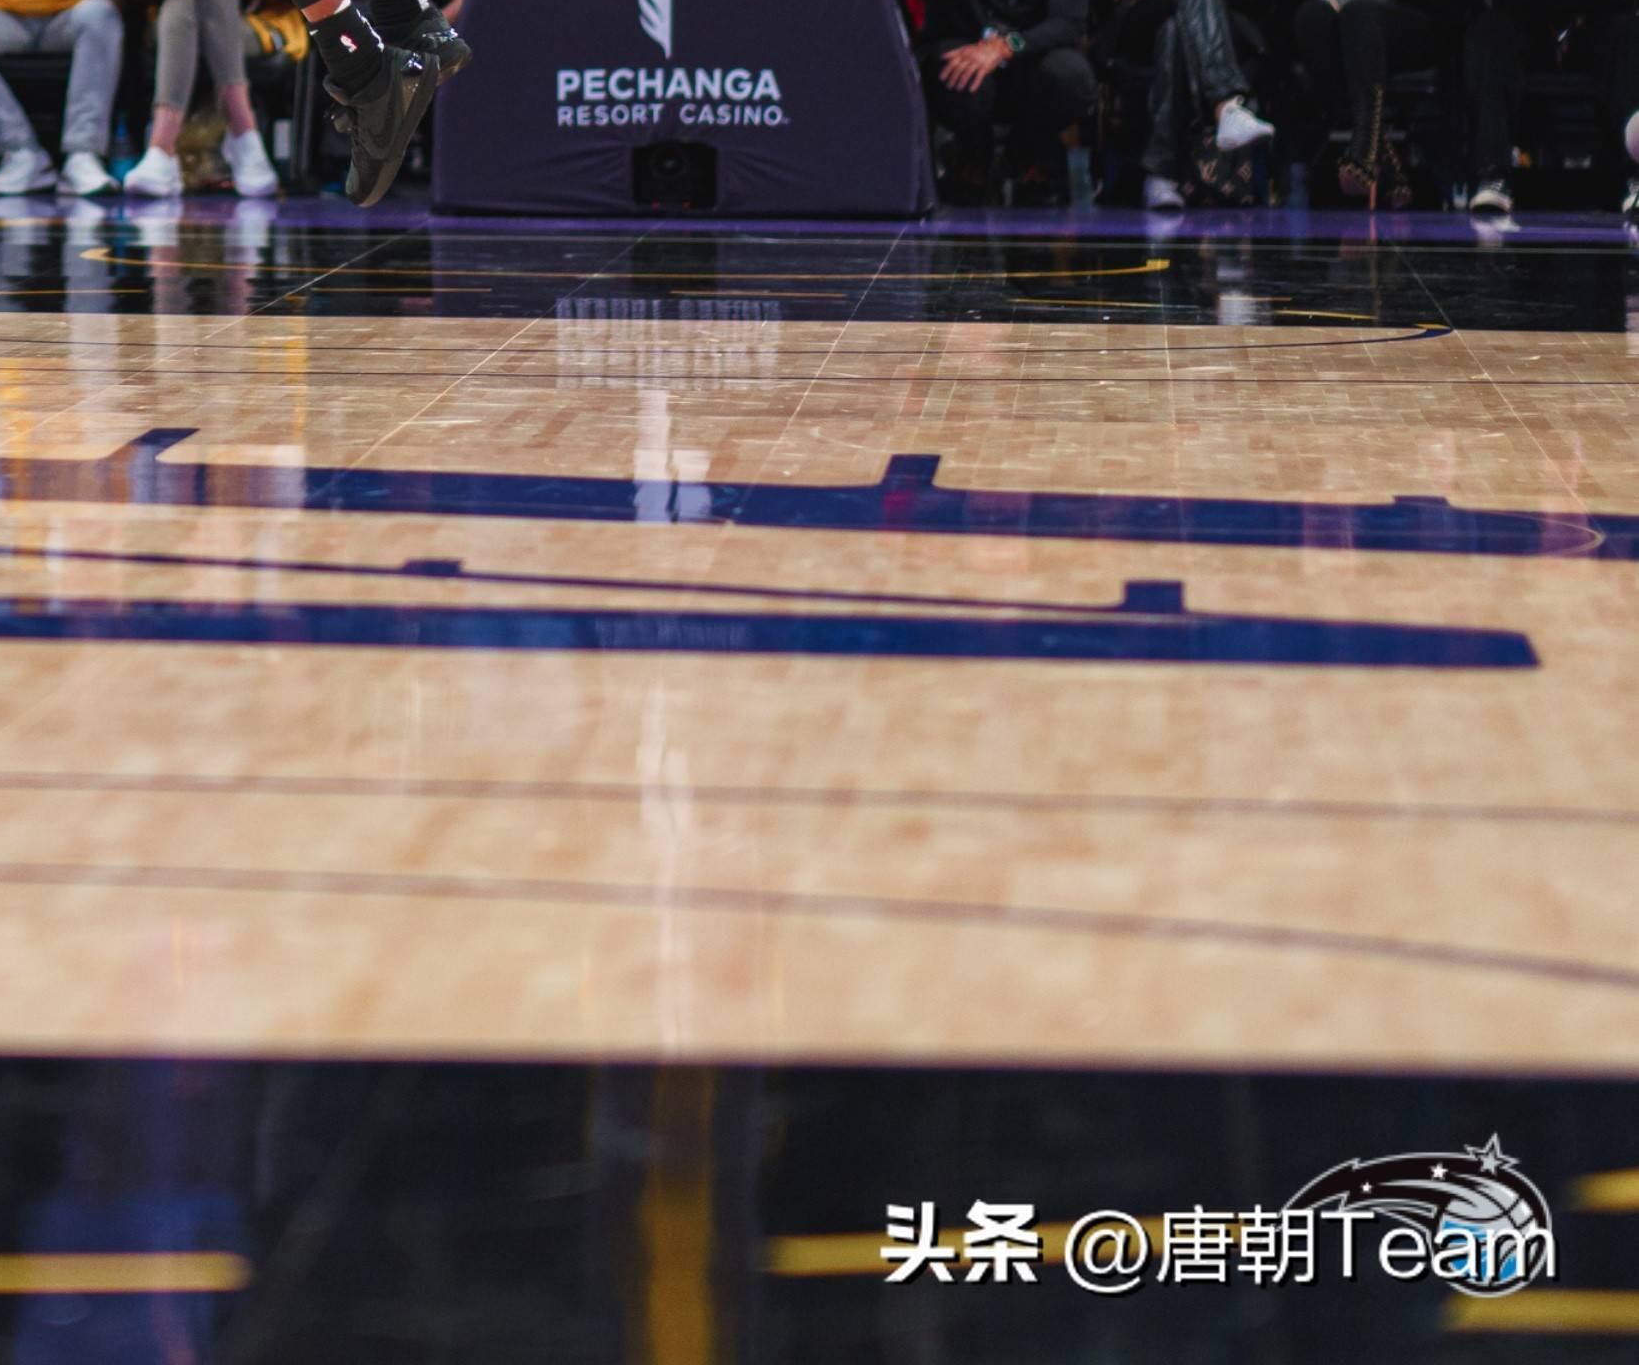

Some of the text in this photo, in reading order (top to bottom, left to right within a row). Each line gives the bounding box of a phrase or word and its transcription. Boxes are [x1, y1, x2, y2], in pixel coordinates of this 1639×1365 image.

[556, 68, 782, 101] PECHANGA
[557, 103, 783, 126] RESORT CASINO
